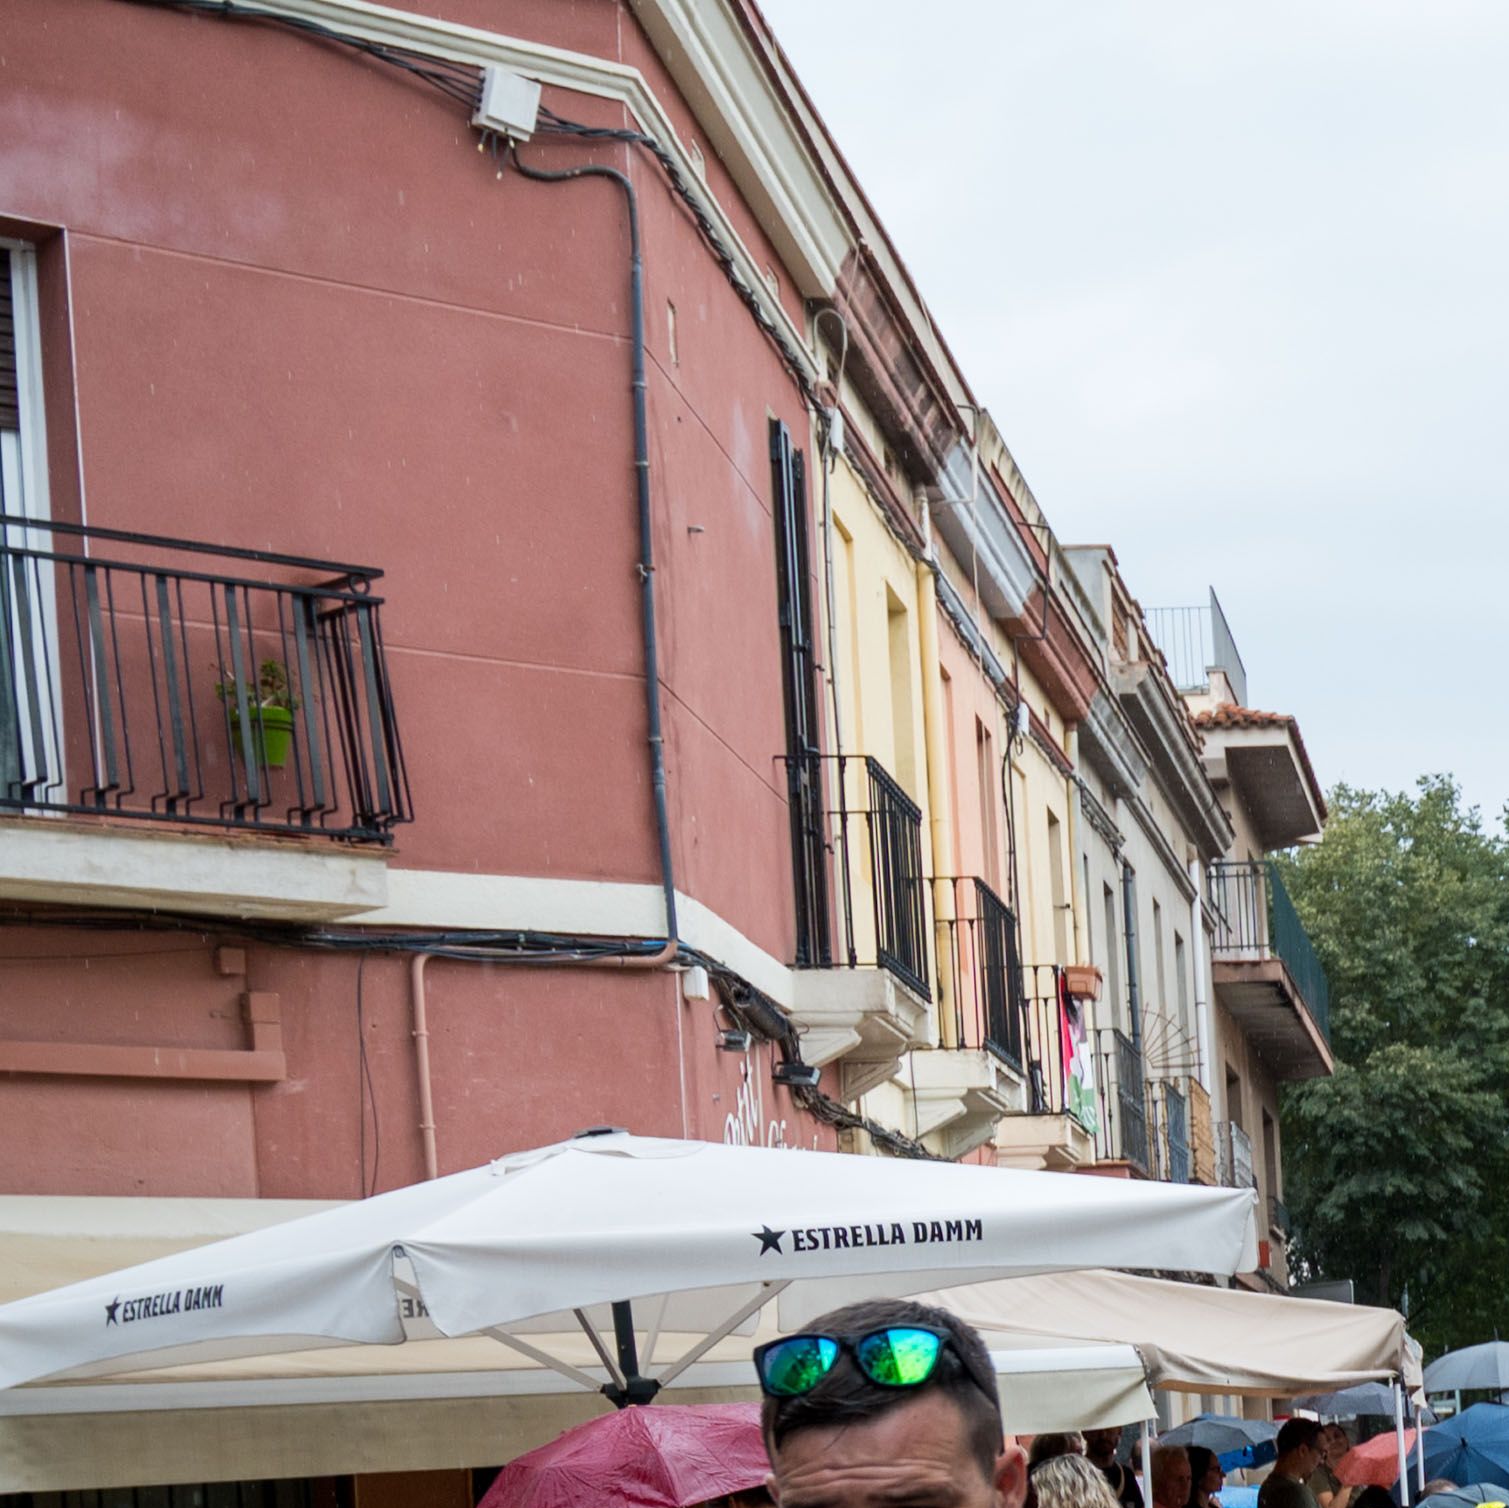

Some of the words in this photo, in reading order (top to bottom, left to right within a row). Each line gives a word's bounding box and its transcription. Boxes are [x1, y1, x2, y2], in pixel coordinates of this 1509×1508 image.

[791, 1222, 906, 1252] ESTRELLA
[912, 1218, 984, 1245] DAMM
[122, 1290, 181, 1323] ESTRELLA
[184, 1284, 225, 1312] DAMM
